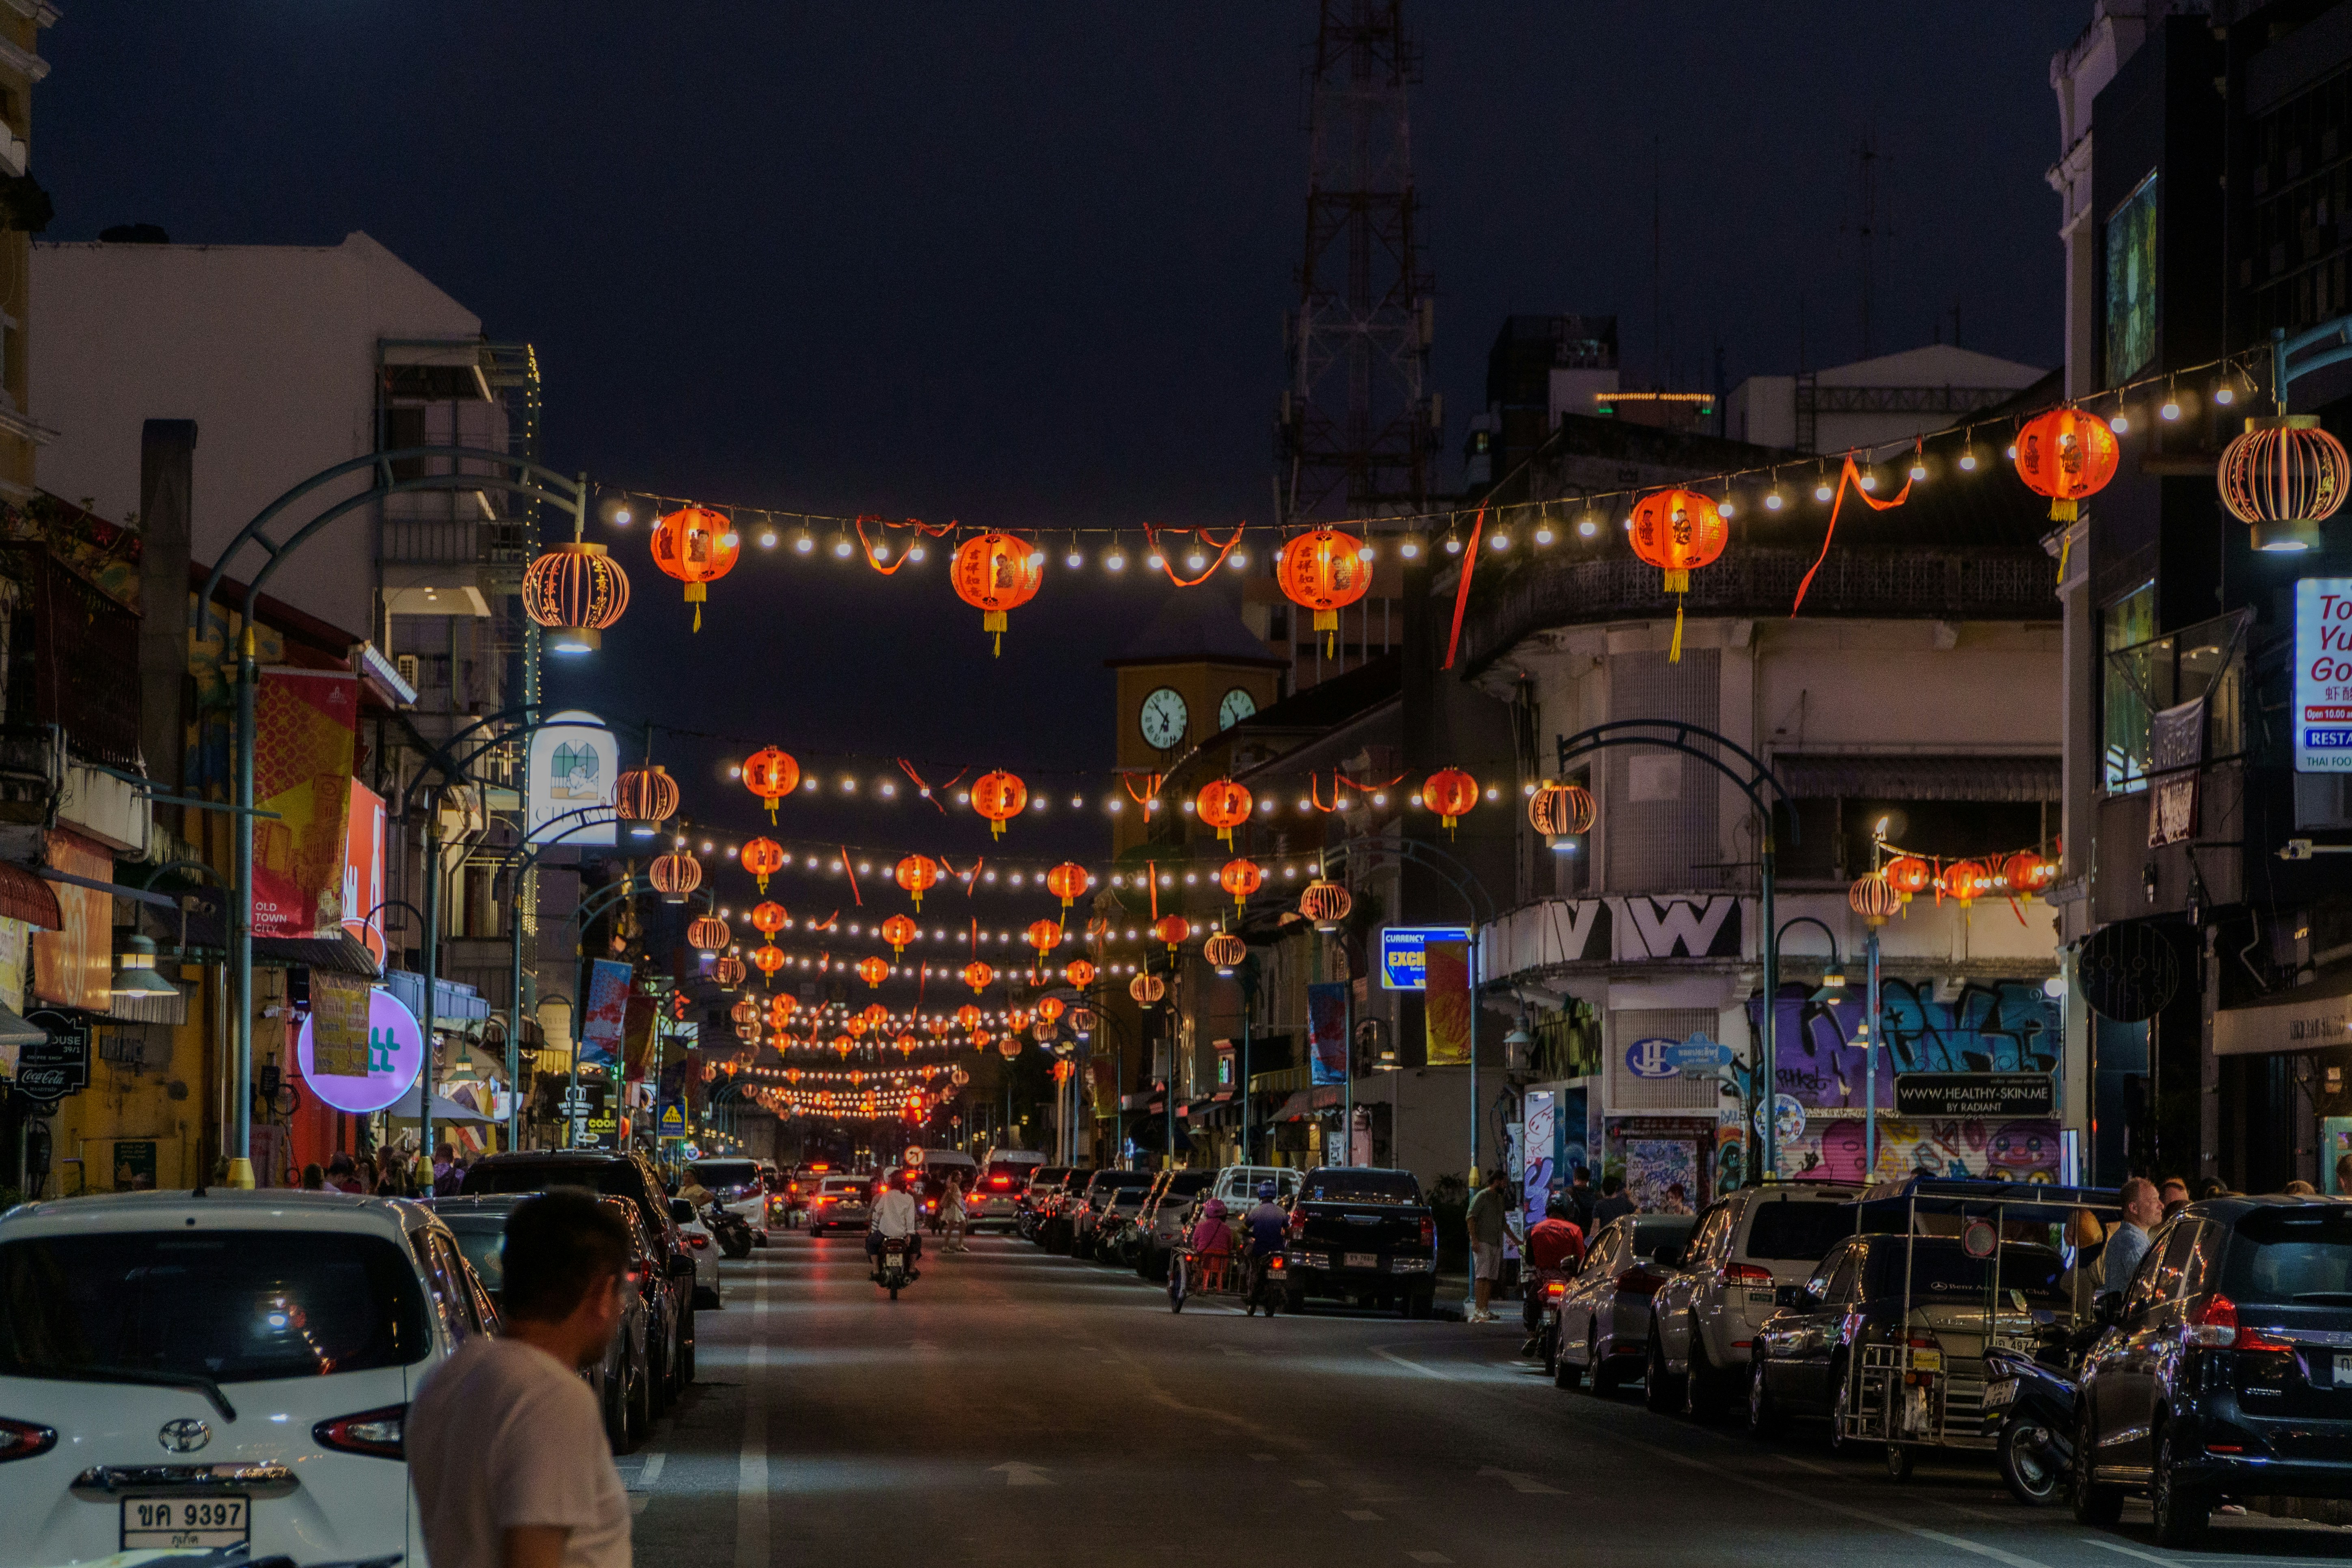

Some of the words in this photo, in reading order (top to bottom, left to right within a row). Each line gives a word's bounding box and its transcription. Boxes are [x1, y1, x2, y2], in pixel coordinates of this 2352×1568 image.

[965, 549, 982, 597] 吉祥如意
[1296, 546, 1317, 596] 吉祥如意
[2307, 709, 2323, 720] Open
[2325, 708, 2345, 719] 10.00
[2307, 756, 2328, 766] THAI
[255, 902, 277, 912] OLD
[255, 912, 287, 923] TOWN
[254, 923, 278, 933] CITY
[1385, 934, 1425, 943] CURRENCY
[21, 1069, 67, 1085] Coca-Cola
[1900, 1087, 2048, 1100] WWW.HEALTHY-SKIN.ME
[1947, 1102, 1957, 1112] BY
[1961, 1102, 2002, 1112] RADIANT
[588, 1119, 616, 1128] COOK
[2025, 1288, 2050, 1296] Club
[184, 1504, 241, 1525] 9397
